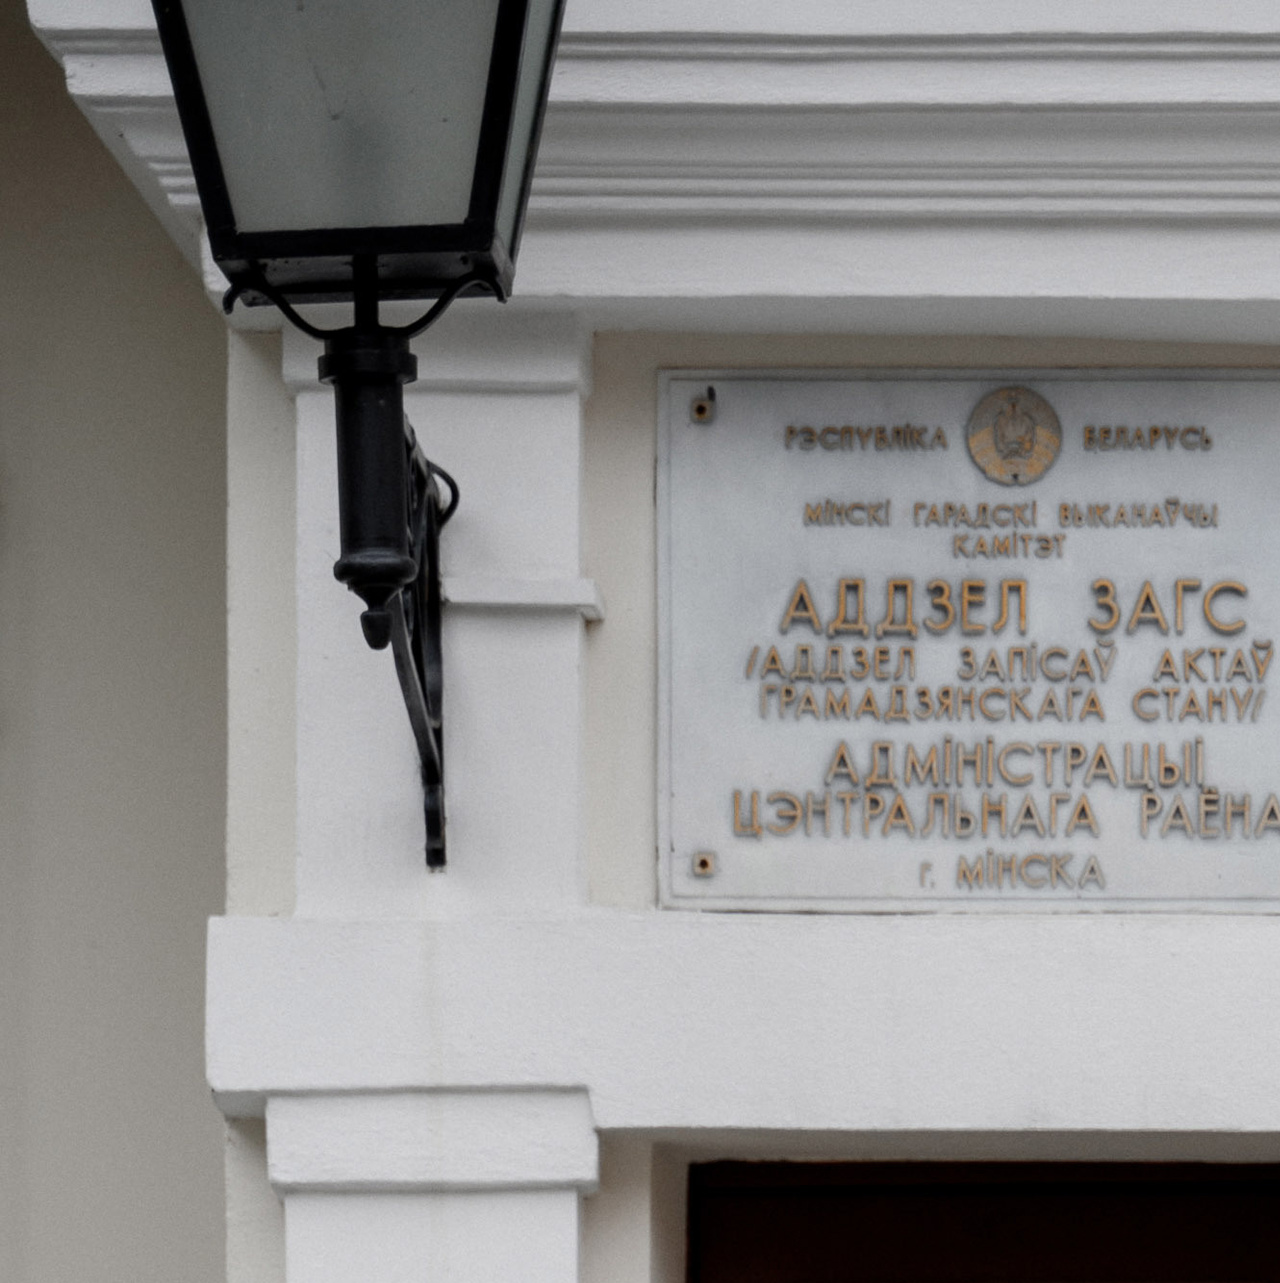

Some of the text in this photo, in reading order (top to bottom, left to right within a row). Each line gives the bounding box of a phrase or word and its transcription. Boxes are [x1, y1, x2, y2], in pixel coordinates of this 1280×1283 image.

[785, 422, 1212, 451] РЭСПУБЛІКА БЕЛАРУСЬ
[805, 498, 1218, 529] МІНСКІ ГАРАДСКІ ВЫКАНАЎЧЫ
[953, 532, 1067, 558] КАМІТЭТ
[782, 579, 1247, 635] АДДЗЕЛ ЗАГС
[746, 640, 1274, 682] /АДДЗЕЛ ЗАПІСАЎ АКТАЎ
[760, 687, 1264, 722] ГРАМАДЗЯНСКАГА СТАНУ/
[826, 738, 1204, 791] АДМІНІСТРАЦЫІ
[734, 791, 1098, 839] ЦЭНТРАЛЬНАГА
[958, 849, 1105, 888] МІНСКА
